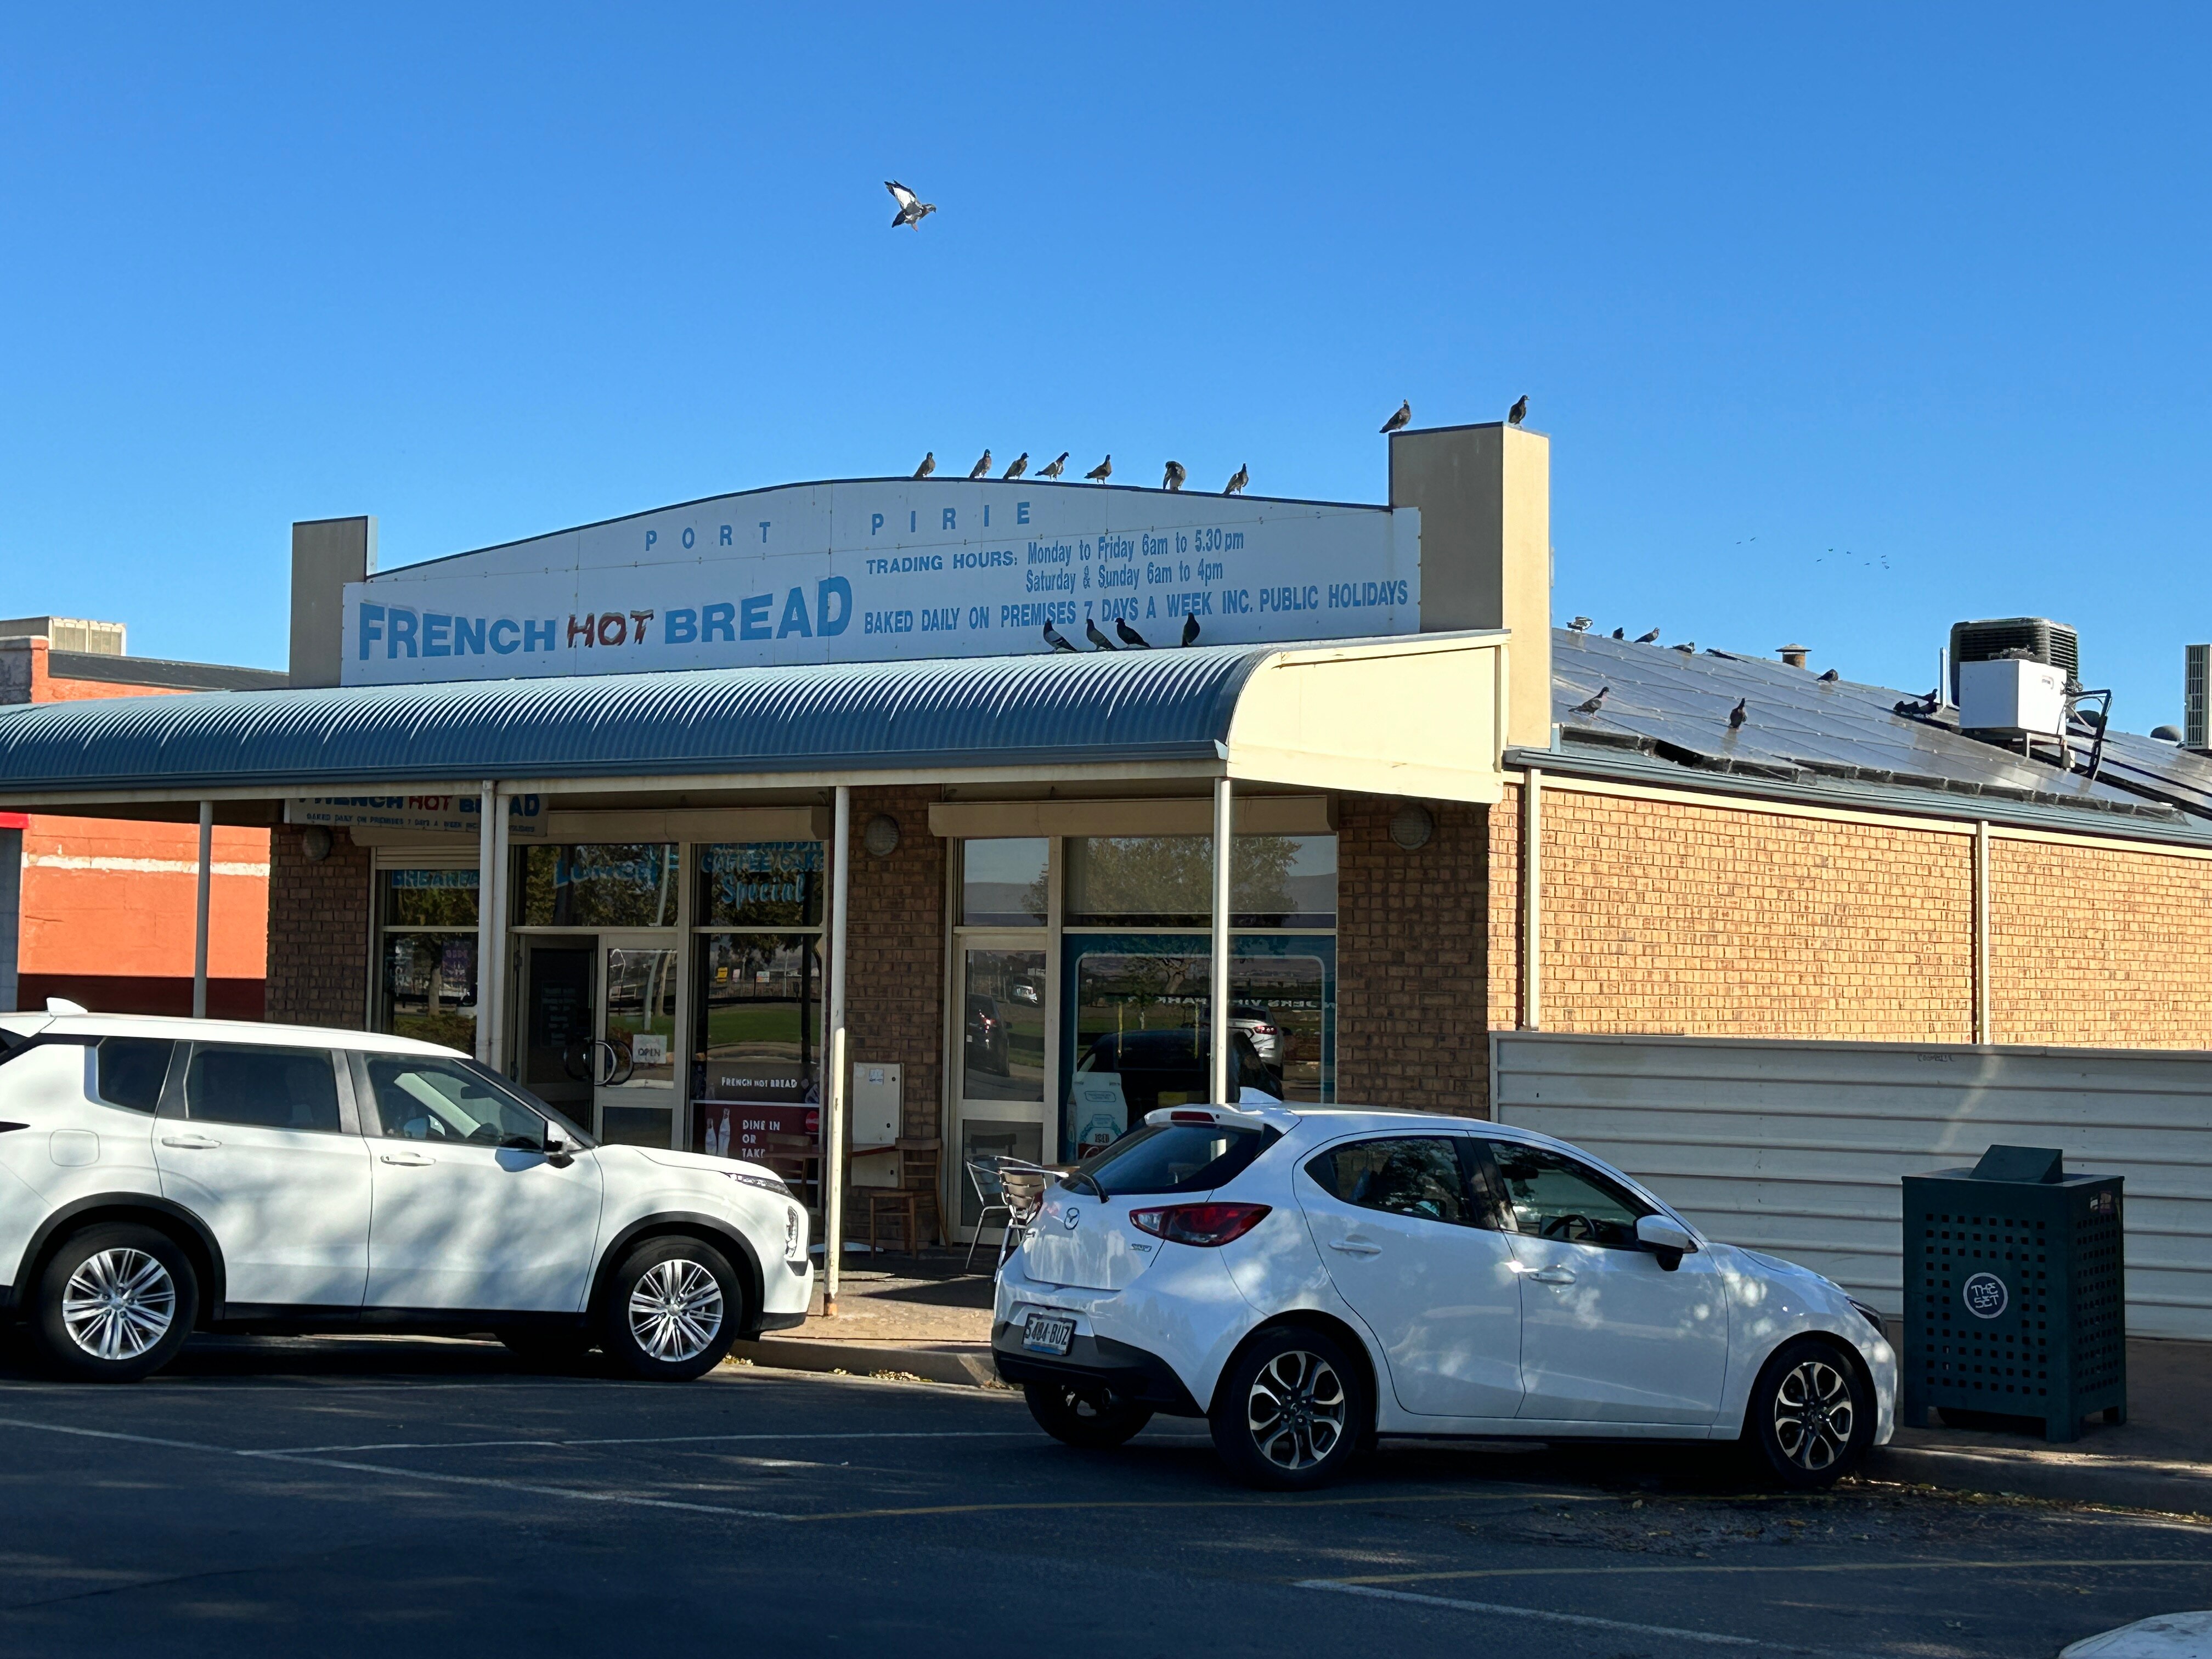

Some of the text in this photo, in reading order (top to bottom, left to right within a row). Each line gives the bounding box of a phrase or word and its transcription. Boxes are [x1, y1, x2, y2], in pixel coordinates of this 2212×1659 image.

[646, 502, 1030, 551] PORT PIRIE
[866, 555, 943, 574] TRADING
[953, 551, 1017, 569] HOURS:
[1028, 540, 1071, 566] Monday
[1080, 539, 1091, 561] to
[1098, 535, 1134, 562] Friday
[1143, 534, 1167, 556] 6am
[1176, 532, 1187, 553] to
[1026, 558, 1223, 594] Saturday & Sunday 6am to 4pm
[359, 576, 852, 661] FRENCH HOT BREAD
[865, 580, 1408, 634] BAKED DAILY ON PREMISES 7 DAYS A WEEK INC. PUBLIC HOLIDAYS
[409, 795, 453, 811] HOT
[460, 794, 539, 816] BAD
[720, 872, 805, 911] Special
[721, 1076, 752, 1086] FRENCH
[770, 1079, 798, 1088] BREAD
[742, 1119, 781, 1131] DINE IN
[742, 1134, 757, 1144] OR
[1971, 1282, 1999, 1297] THE
[1973, 1294, 2000, 1308] SET
